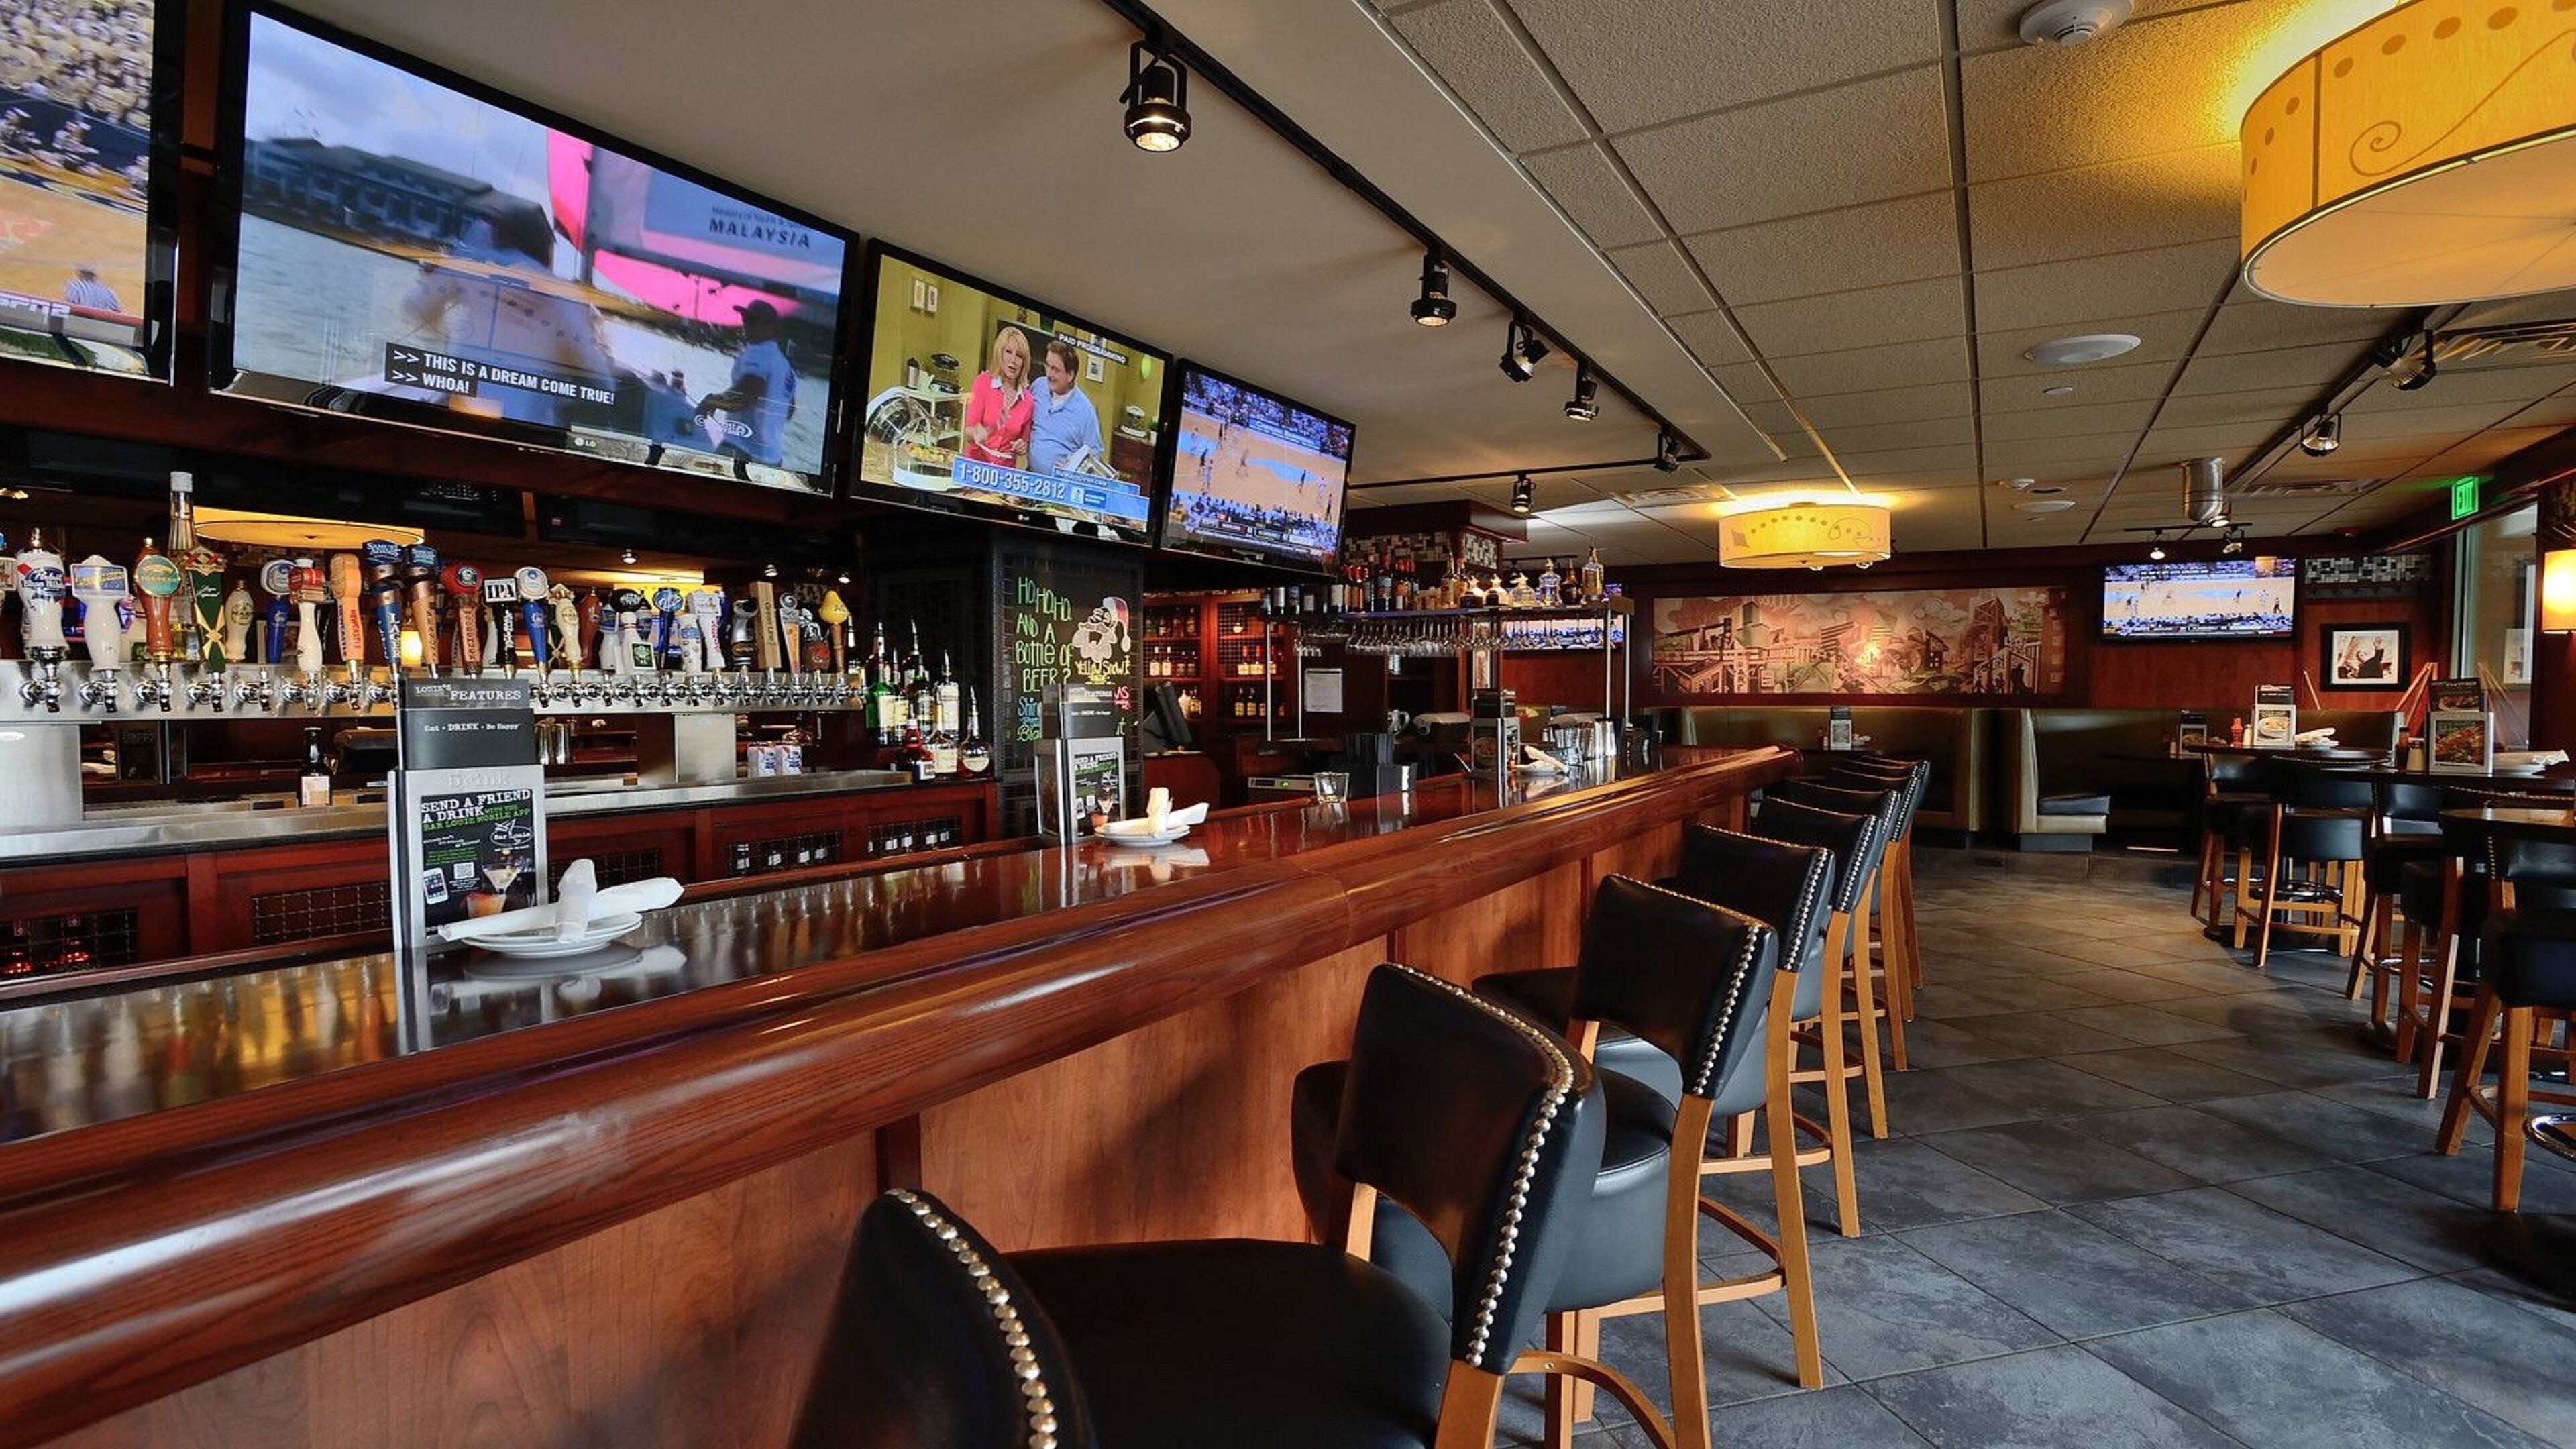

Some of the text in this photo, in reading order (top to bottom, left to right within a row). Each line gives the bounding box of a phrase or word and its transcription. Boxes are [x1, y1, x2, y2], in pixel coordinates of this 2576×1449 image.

[709, 218, 810, 248] MALAYSIA
[1059, 334, 1076, 345] PAID
[422, 373, 470, 394] WHOA!
[424, 353, 456, 372] THIS
[462, 362, 476, 376] IS
[478, 367, 488, 378] A
[491, 368, 537, 389] DREAM
[541, 378, 576, 396] COME
[580, 386, 614, 405] TRUE!
[959, 463, 1066, 499] 1-800-355-2812
[487, 584, 515, 599] IPA
[388, 613, 401, 658] LAGER
[1044, 623, 1055, 644] A
[1023, 668, 1058, 692] BEER
[450, 690, 521, 700] FEATURES
[448, 722, 479, 731] DRINK
[421, 789, 531, 813] SEND A FRIEND
[422, 813, 433, 824] A
[436, 806, 484, 822] DRINK
[423, 822, 444, 833] BAR
[446, 817, 476, 828] LOUIE
[513, 809, 530, 818] APP
